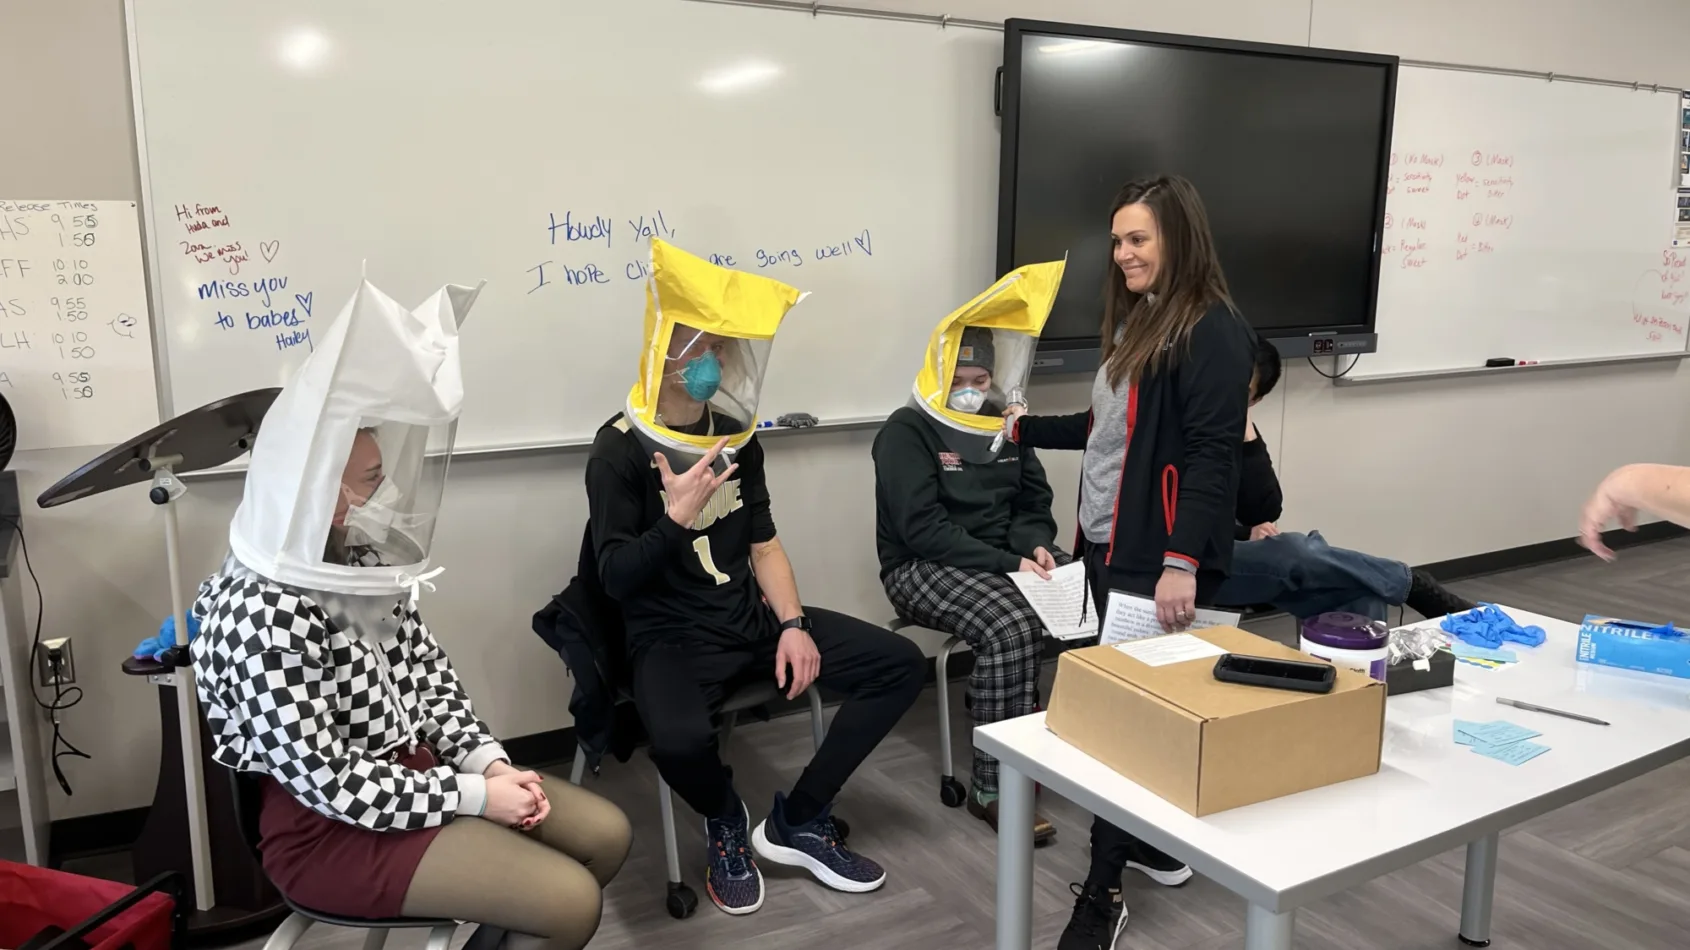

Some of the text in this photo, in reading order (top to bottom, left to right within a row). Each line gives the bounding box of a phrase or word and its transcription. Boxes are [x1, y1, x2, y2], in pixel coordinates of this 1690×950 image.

[57, 201, 98, 212] Times
[175, 203, 222, 221] Hi from
[212, 215, 230, 227] and
[548, 211, 611, 248] Howdy
[526, 260, 554, 295] I
[709, 253, 737, 267] are
[756, 249, 803, 268] going
[816, 241, 852, 260] well
[254, 276, 288, 308] you
[214, 308, 305, 331] to babes
[692, 535, 731, 586] 1
[1580, 624, 1653, 640] NITRILE
